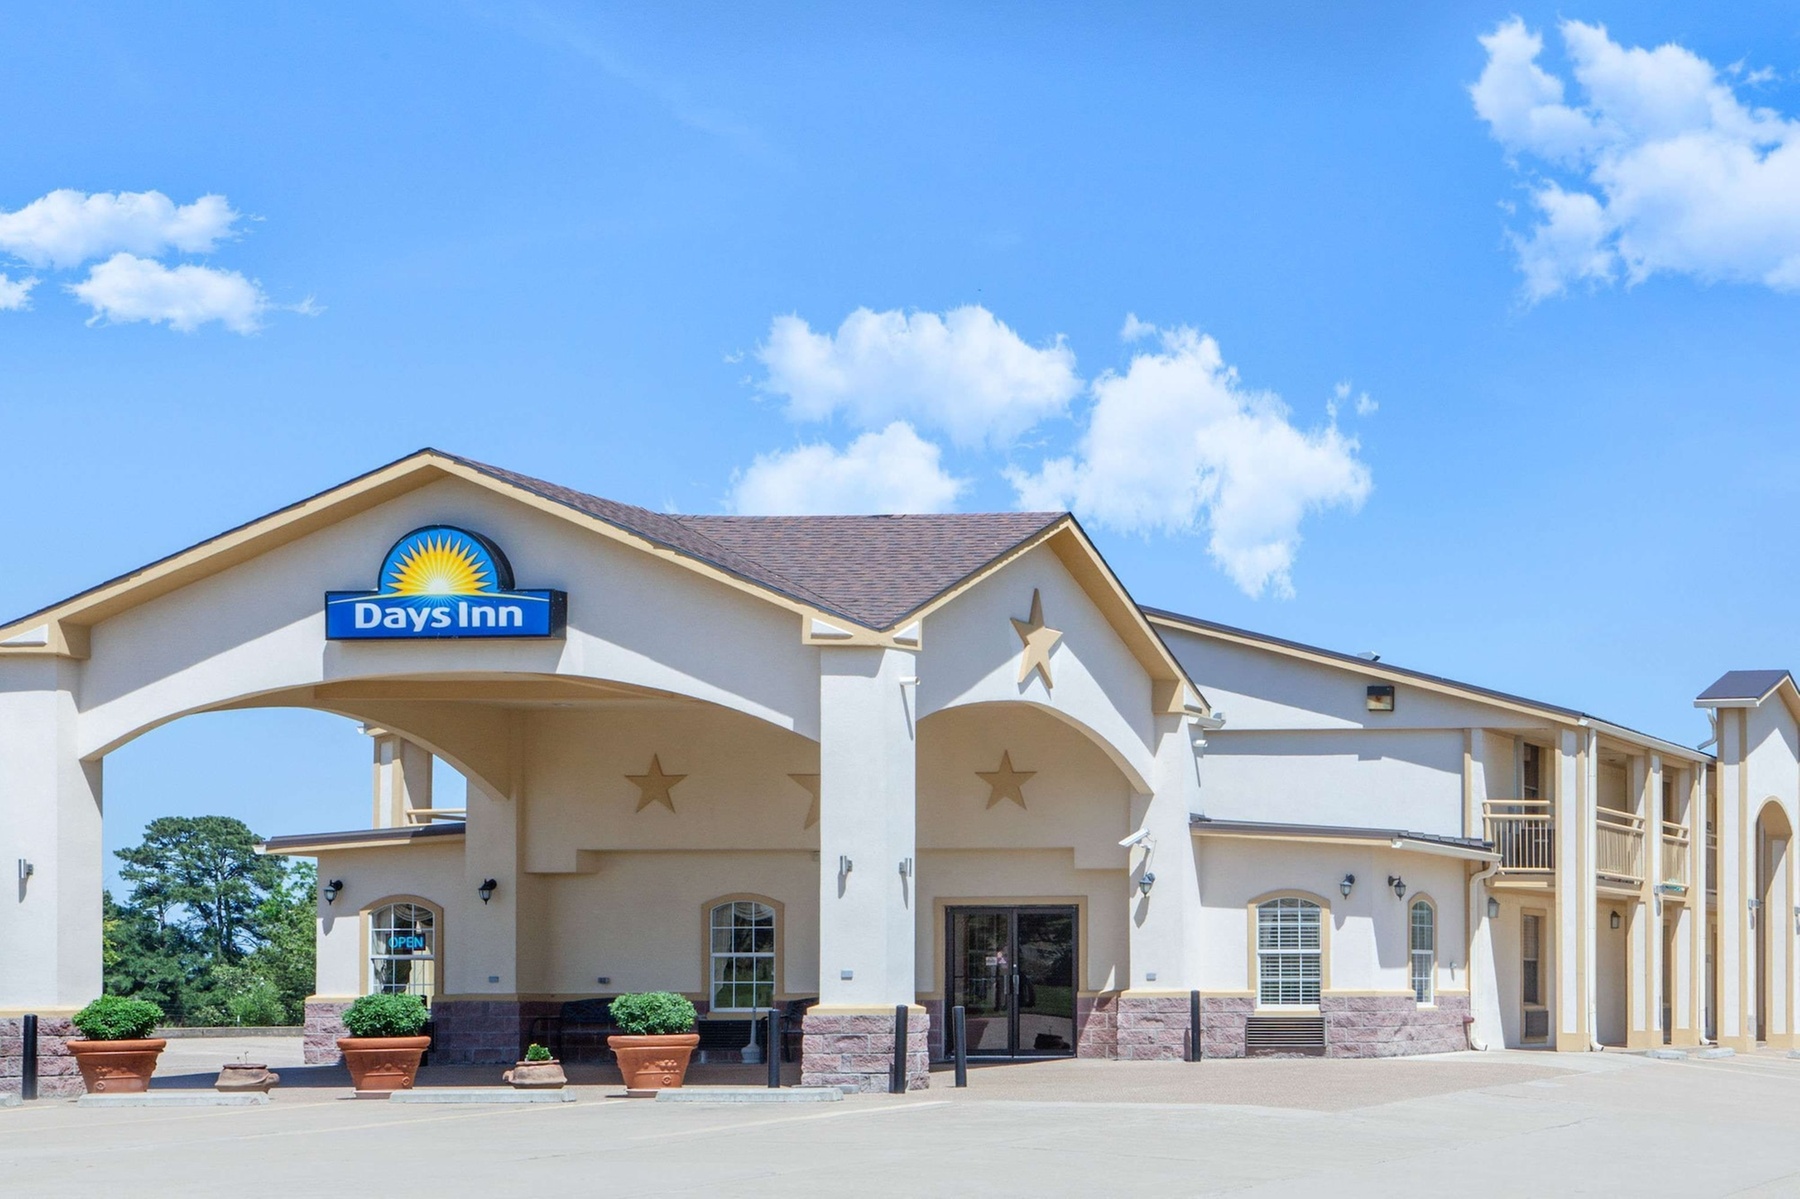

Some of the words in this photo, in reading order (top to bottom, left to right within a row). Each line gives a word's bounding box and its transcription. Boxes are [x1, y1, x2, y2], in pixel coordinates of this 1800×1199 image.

[354, 602, 451, 632] Days
[458, 601, 523, 628] Inn
[387, 936, 424, 949] OPEN
